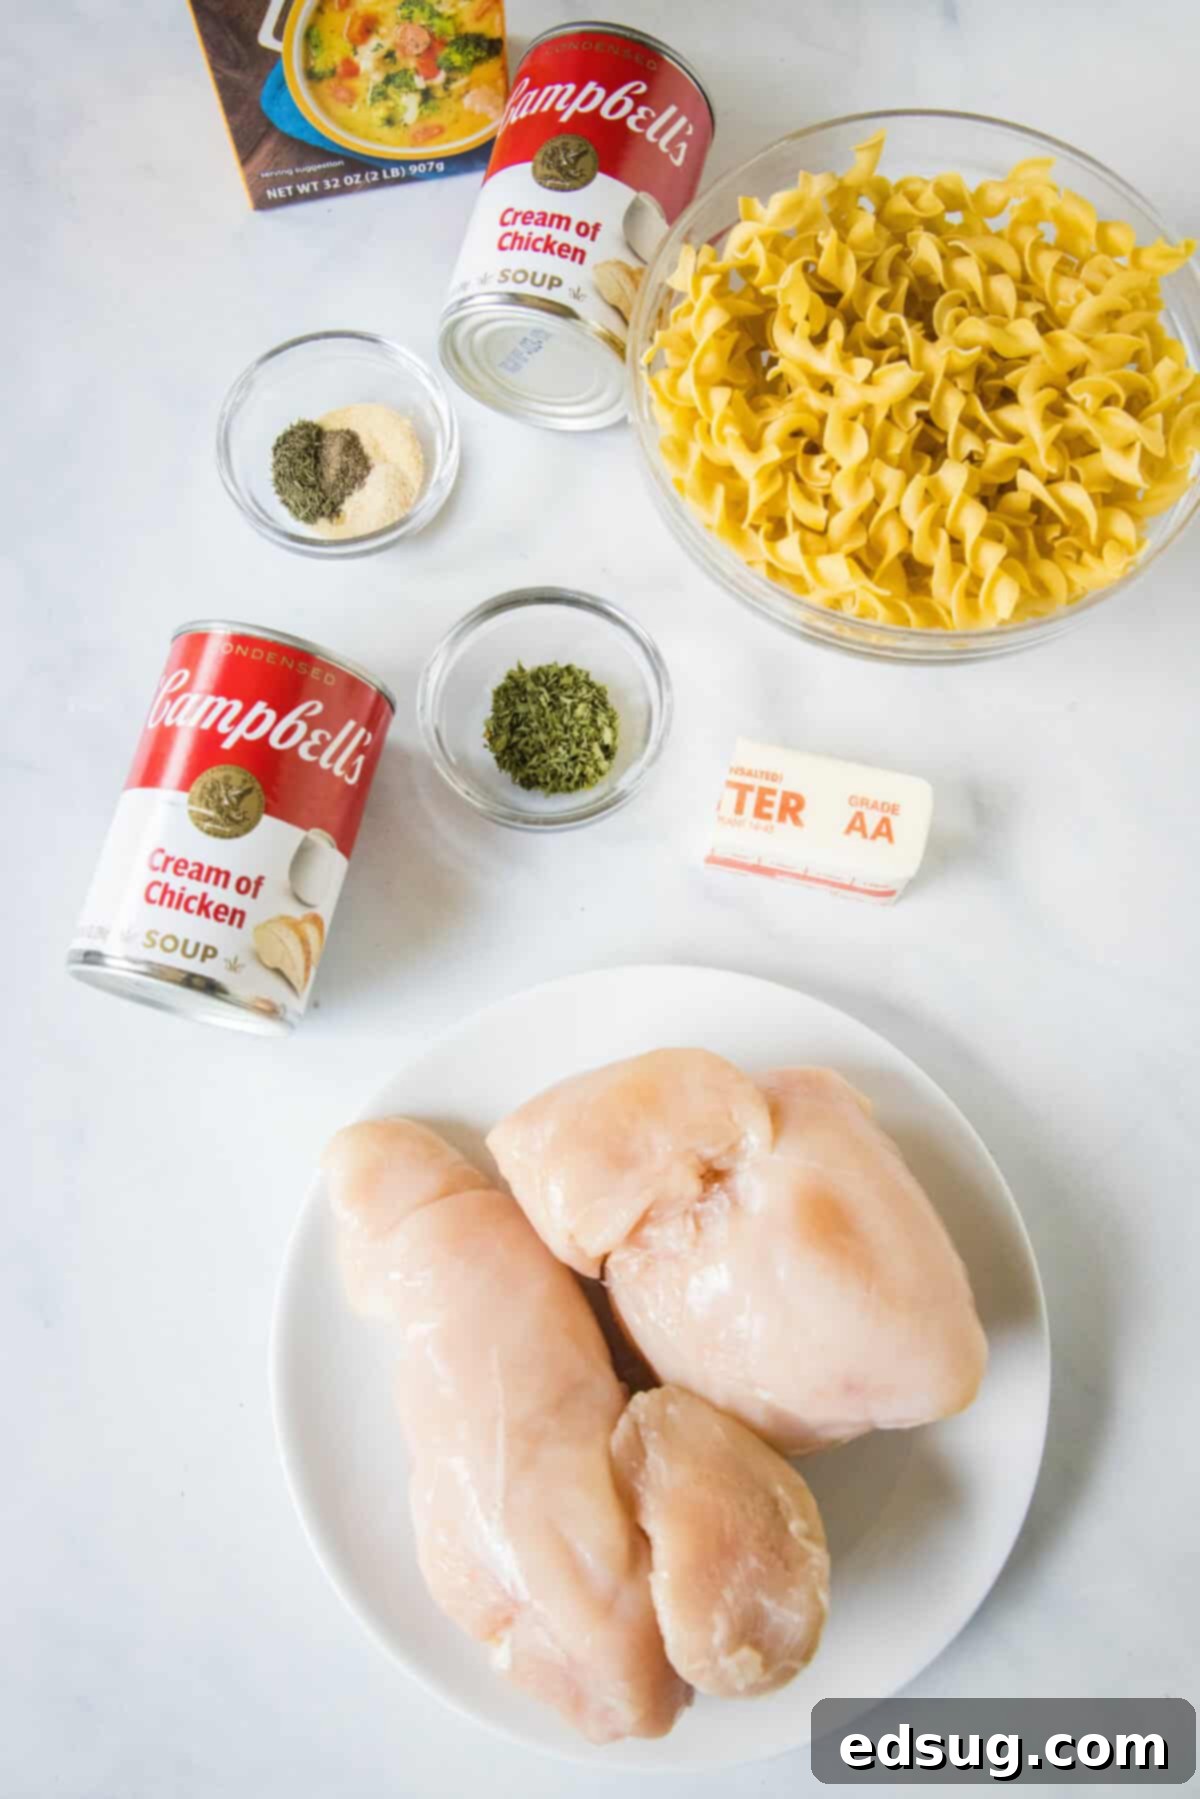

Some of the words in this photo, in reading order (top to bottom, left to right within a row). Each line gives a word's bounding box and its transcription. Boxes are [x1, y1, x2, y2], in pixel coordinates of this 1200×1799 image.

[260, 167, 294, 178] serving
[294, 160, 345, 174] suggestion
[266, 183, 294, 200] NET
[296, 181, 319, 195] WT
[323, 178, 342, 191] 32
[343, 173, 363, 187] OZ
[364, 171, 380, 184] (2
[382, 166, 406, 180] LB)
[409, 161, 445, 175] 907g
[499, 207, 572, 232] Cream
[575, 221, 603, 242] of
[497, 231, 587, 266] Chicken
[497, 268, 563, 291] SOUP
[213, 641, 337, 686] ONDENSED
[148, 669, 372, 785] Campbell's
[847, 794, 901, 816] GRADE
[842, 810, 895, 845] AA
[148, 848, 231, 890] Cream
[235, 875, 266, 900] of
[144, 880, 247, 930] Chicken
[142, 929, 219, 963] SOUP
